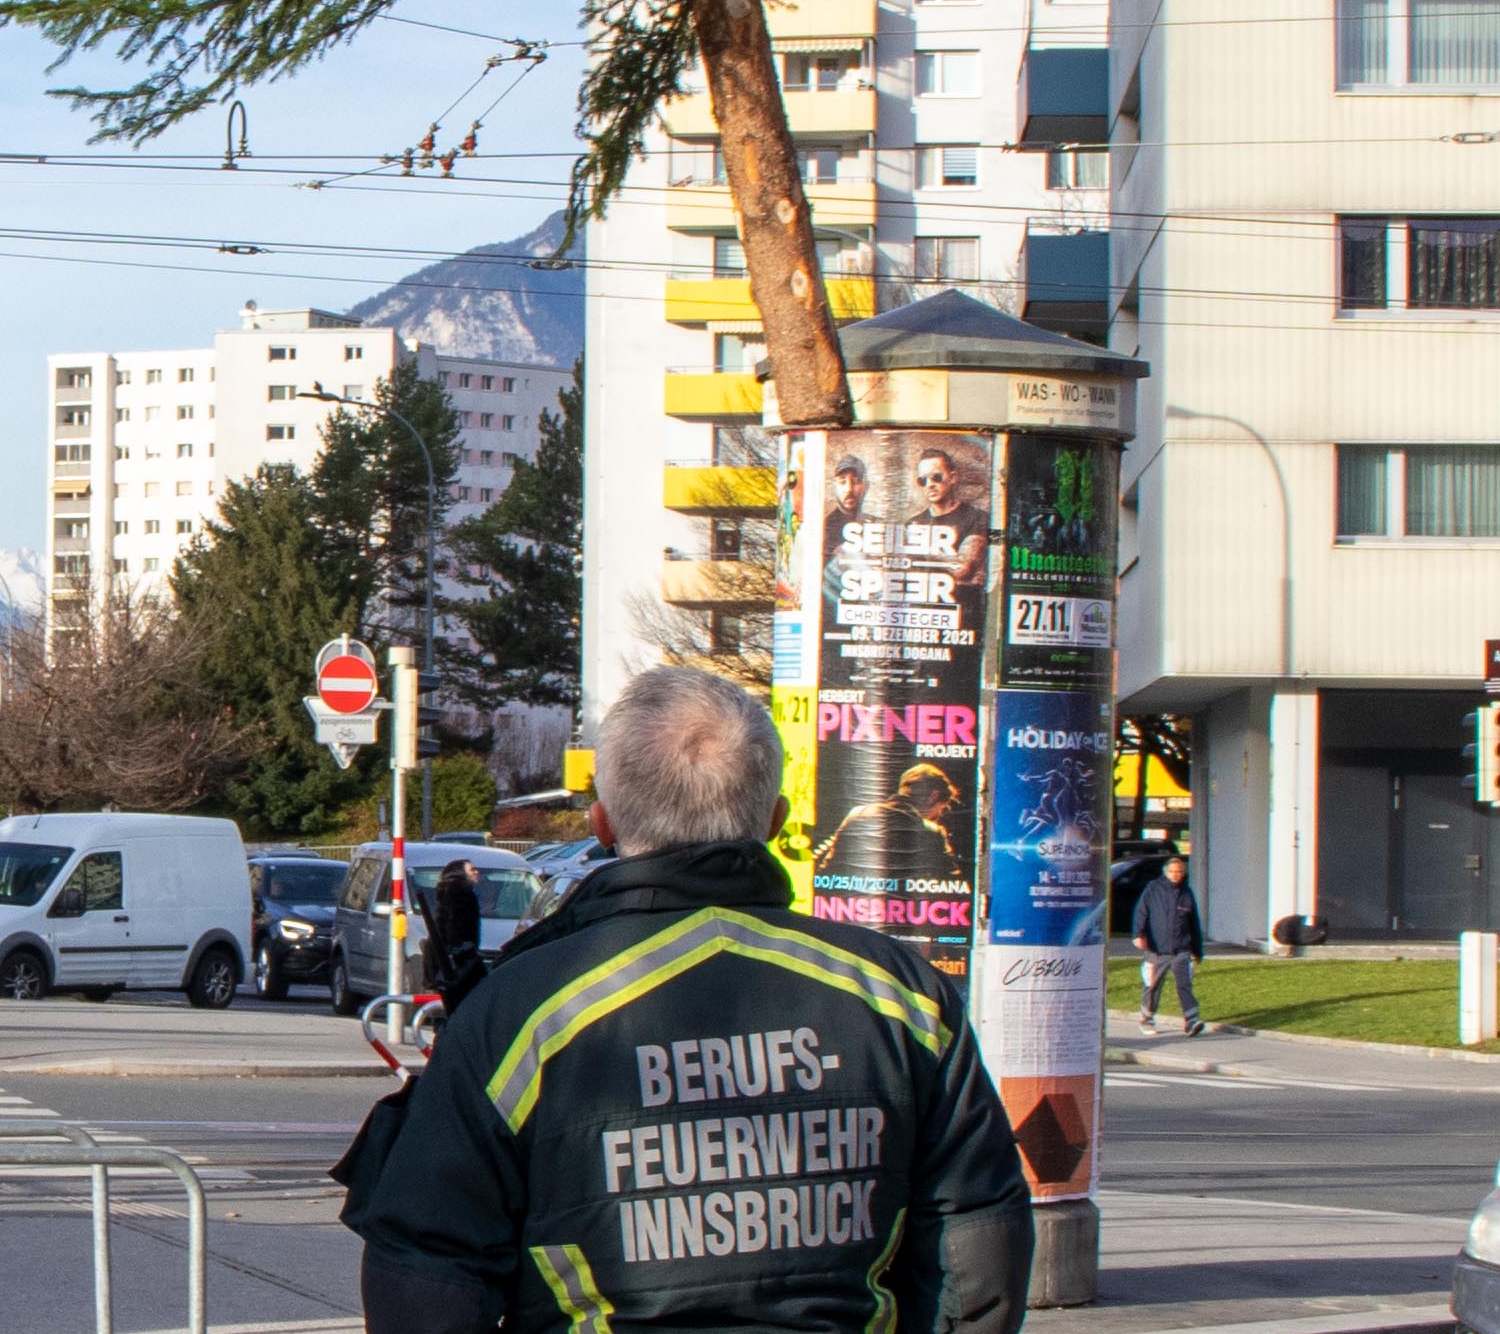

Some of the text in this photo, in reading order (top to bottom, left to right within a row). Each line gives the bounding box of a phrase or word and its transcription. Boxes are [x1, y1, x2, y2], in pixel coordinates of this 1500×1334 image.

[1017, 383, 1048, 401] WAS
[1060, 384, 1080, 403] WO
[1088, 386, 1116, 405] WANN
[842, 522, 959, 556] SEILER
[840, 569, 957, 603] SPEER
[844, 609, 951, 627] CHRIS STEGER
[1016, 599, 1071, 633] 27.11.
[872, 627, 940, 644] DEZEMBER
[942, 629, 975, 645] 2021
[840, 644, 951, 661] INNSBRUCK DOGANA
[818, 689, 866, 704] HERBERT
[818, 703, 977, 745] PIXNER
[916, 744, 977, 759] PROJEKT
[1007, 727, 1083, 750] HOLIDAY
[814, 875, 971, 894] DO/25/11/2021 DOGANA
[814, 895, 971, 927] INNSBRUCK
[635, 1027, 840, 1108] BERUFS-
[601, 1106, 886, 1194] FEUERWEHR
[618, 1179, 877, 1263] INNSBRUCK
